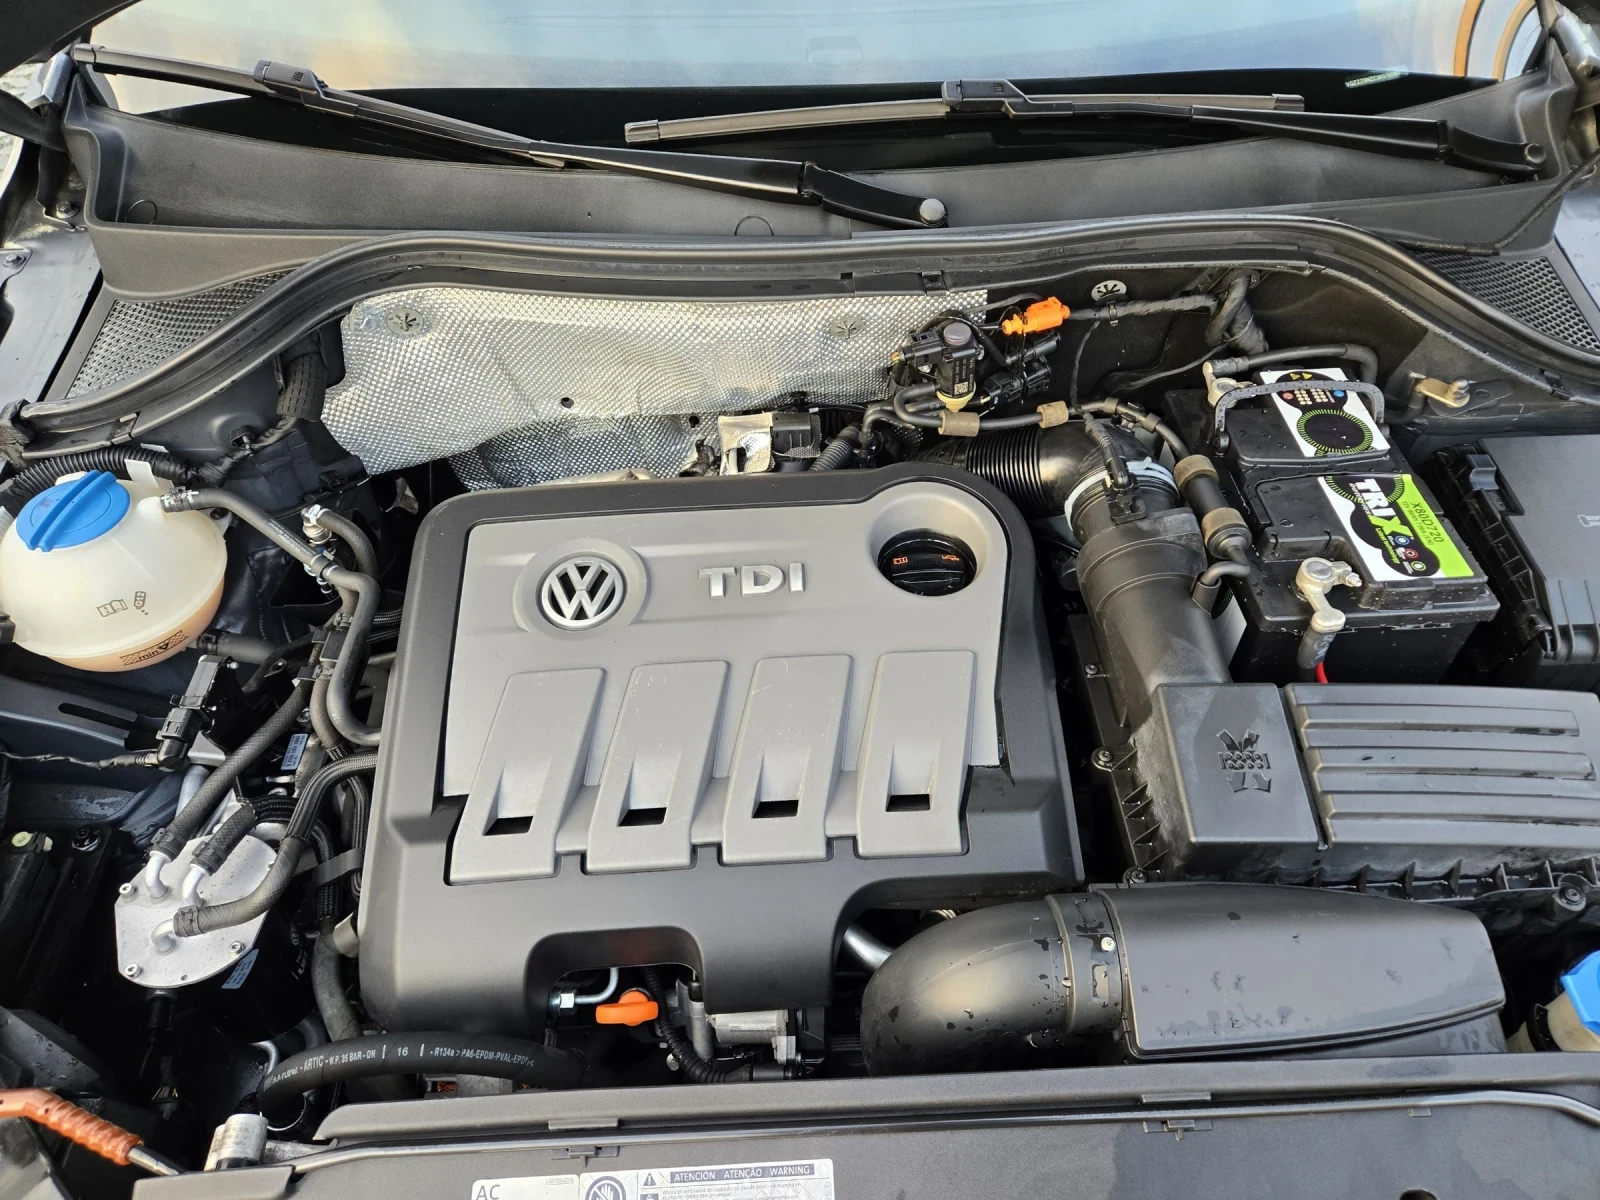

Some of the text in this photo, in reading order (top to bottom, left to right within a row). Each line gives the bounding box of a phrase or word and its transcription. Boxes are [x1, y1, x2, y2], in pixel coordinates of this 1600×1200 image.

[1355, 478, 1413, 537] TRIX
[1411, 502, 1445, 543] X80D720
[698, 562, 805, 599] TDI
[135, 592, 145, 607] G12
[138, 650, 159, 661] min
[303, 1055, 324, 1071] ARTIC
[341, 1053, 348, 1063] 35
[349, 1051, 362, 1062] BAR
[397, 1046, 408, 1057] 16
[434, 1047, 455, 1057] R134a
[674, 1165, 810, 1181] ATENCIÓN ATENÇÃO WARNING
[475, 1184, 500, 1200] AC
